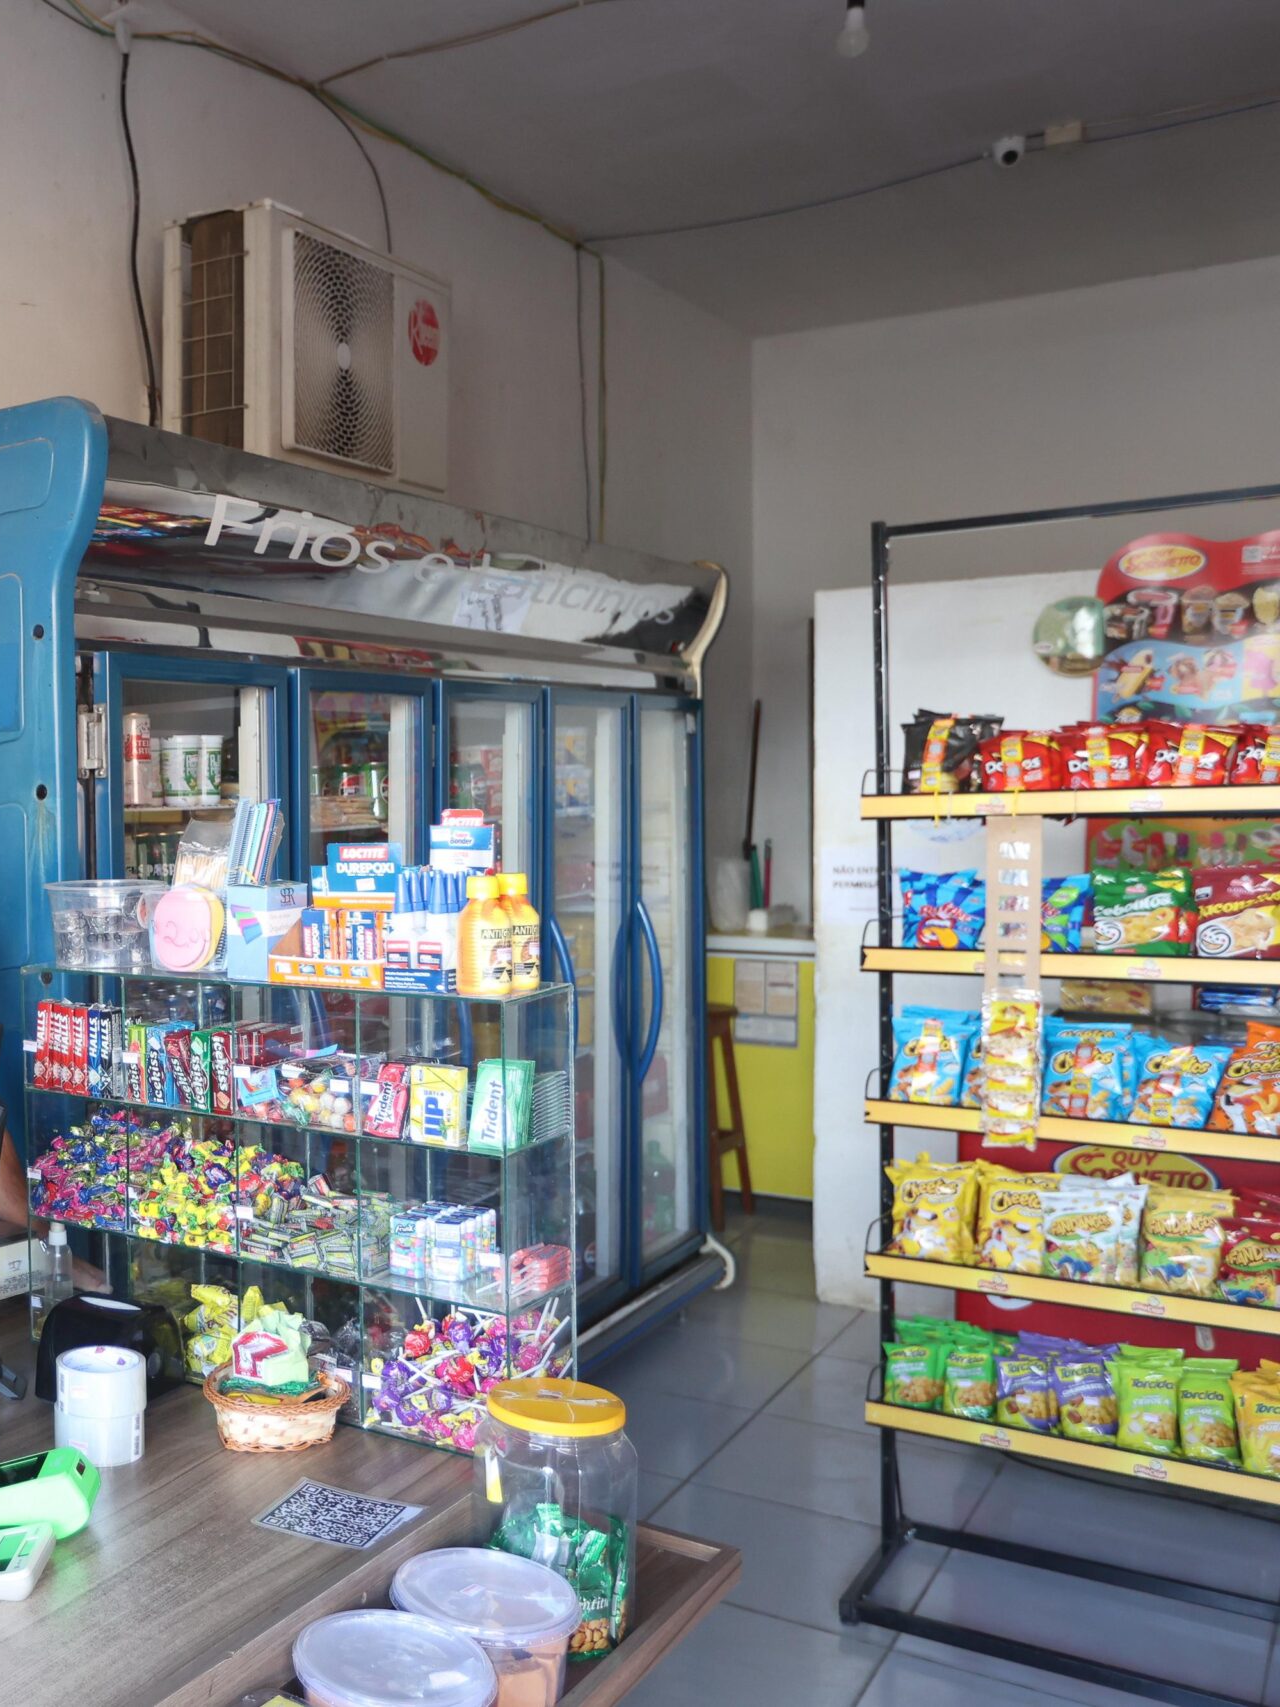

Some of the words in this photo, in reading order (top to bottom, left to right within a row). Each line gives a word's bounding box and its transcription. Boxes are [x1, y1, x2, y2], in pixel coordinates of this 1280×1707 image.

[204, 494, 396, 575] Frios
[414, 554, 454, 584] e
[336, 862, 394, 874] DUREPOXI
[340, 848, 387, 860] LOCTITE
[513, 926, 532, 936] ANTI
[37, 1010, 47, 1050] HALLS
[61, 1015, 69, 1056] HALLS
[74, 1016, 84, 1057] HALLS
[89, 1017, 98, 1058] HALLS
[101, 1018, 110, 1060] HALLS
[374, 1082, 392, 1124] Trident
[480, 1080, 503, 1141] Trident
[1112, 1150, 1158, 1166] QUY
[1132, 1378, 1175, 1390] Torcida
[1180, 1390, 1224, 1401] Torcida
